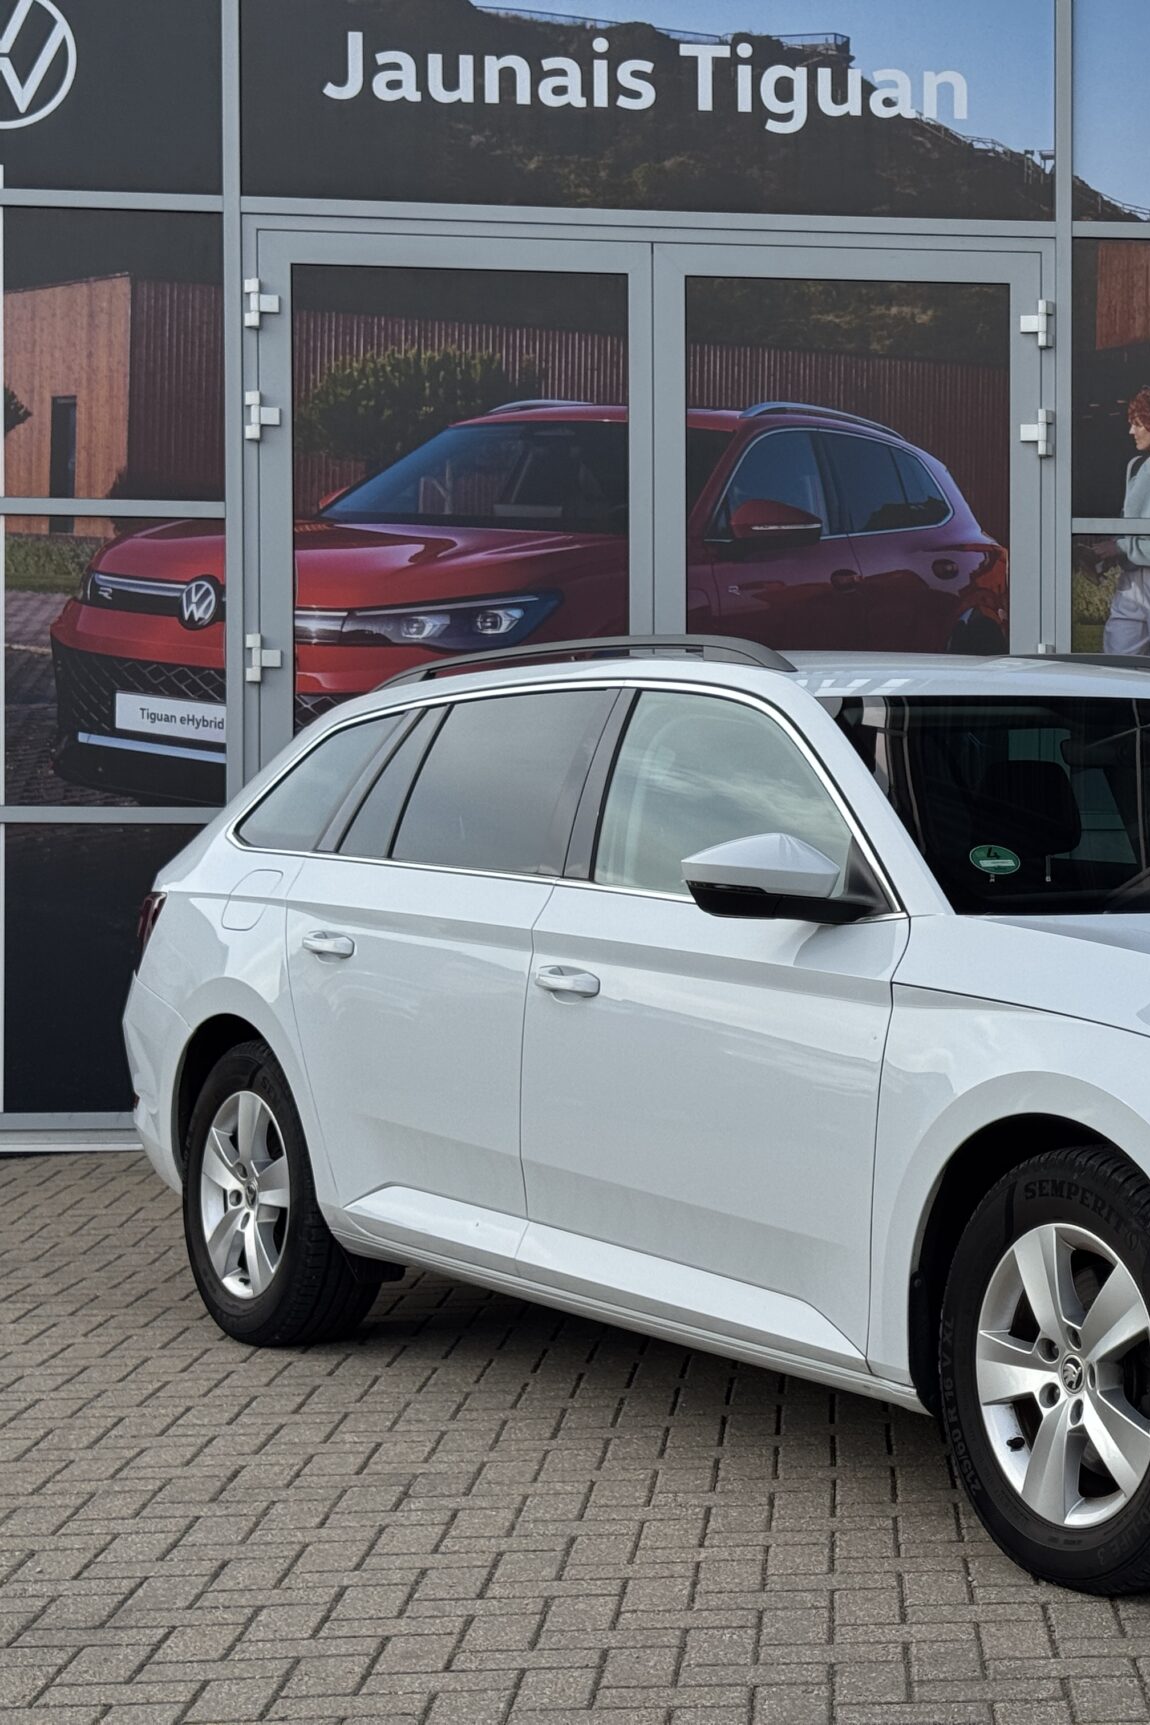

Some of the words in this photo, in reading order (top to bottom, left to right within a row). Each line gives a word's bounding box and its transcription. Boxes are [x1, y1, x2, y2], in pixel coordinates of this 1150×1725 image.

[322, 31, 657, 111] Jaunais
[679, 43, 969, 135] Tiguan
[140, 707, 177, 724] Tiguan
[179, 714, 225, 730] eHybrid
[987, 847, 1000, 859] 4
